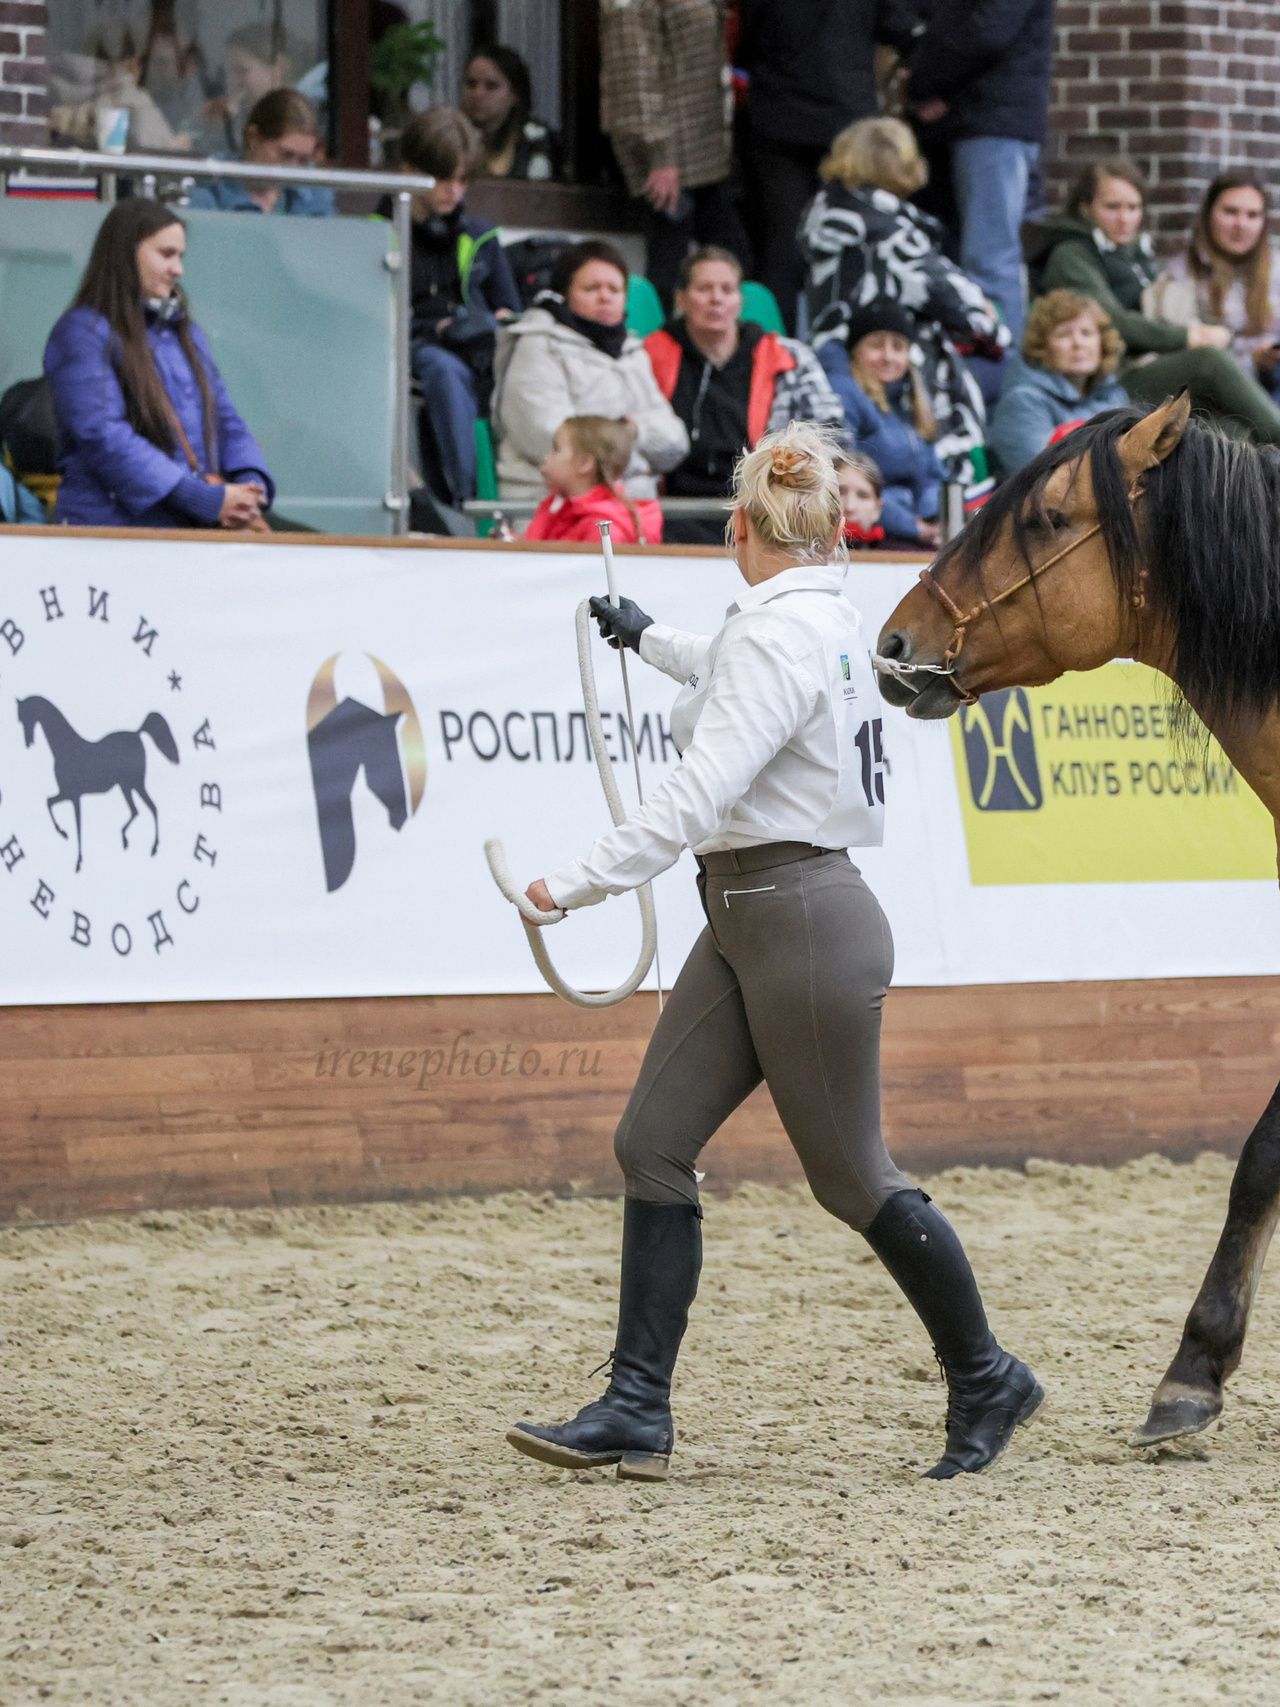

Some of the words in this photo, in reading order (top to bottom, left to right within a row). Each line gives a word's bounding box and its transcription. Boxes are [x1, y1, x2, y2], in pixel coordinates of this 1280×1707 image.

[0, 585, 158, 656] ВНИИ
[1050, 762, 1121, 795] КЛУБ
[1129, 762, 1239, 795] РОССИИ
[0, 718, 221, 956] НЕВОДСТВА
